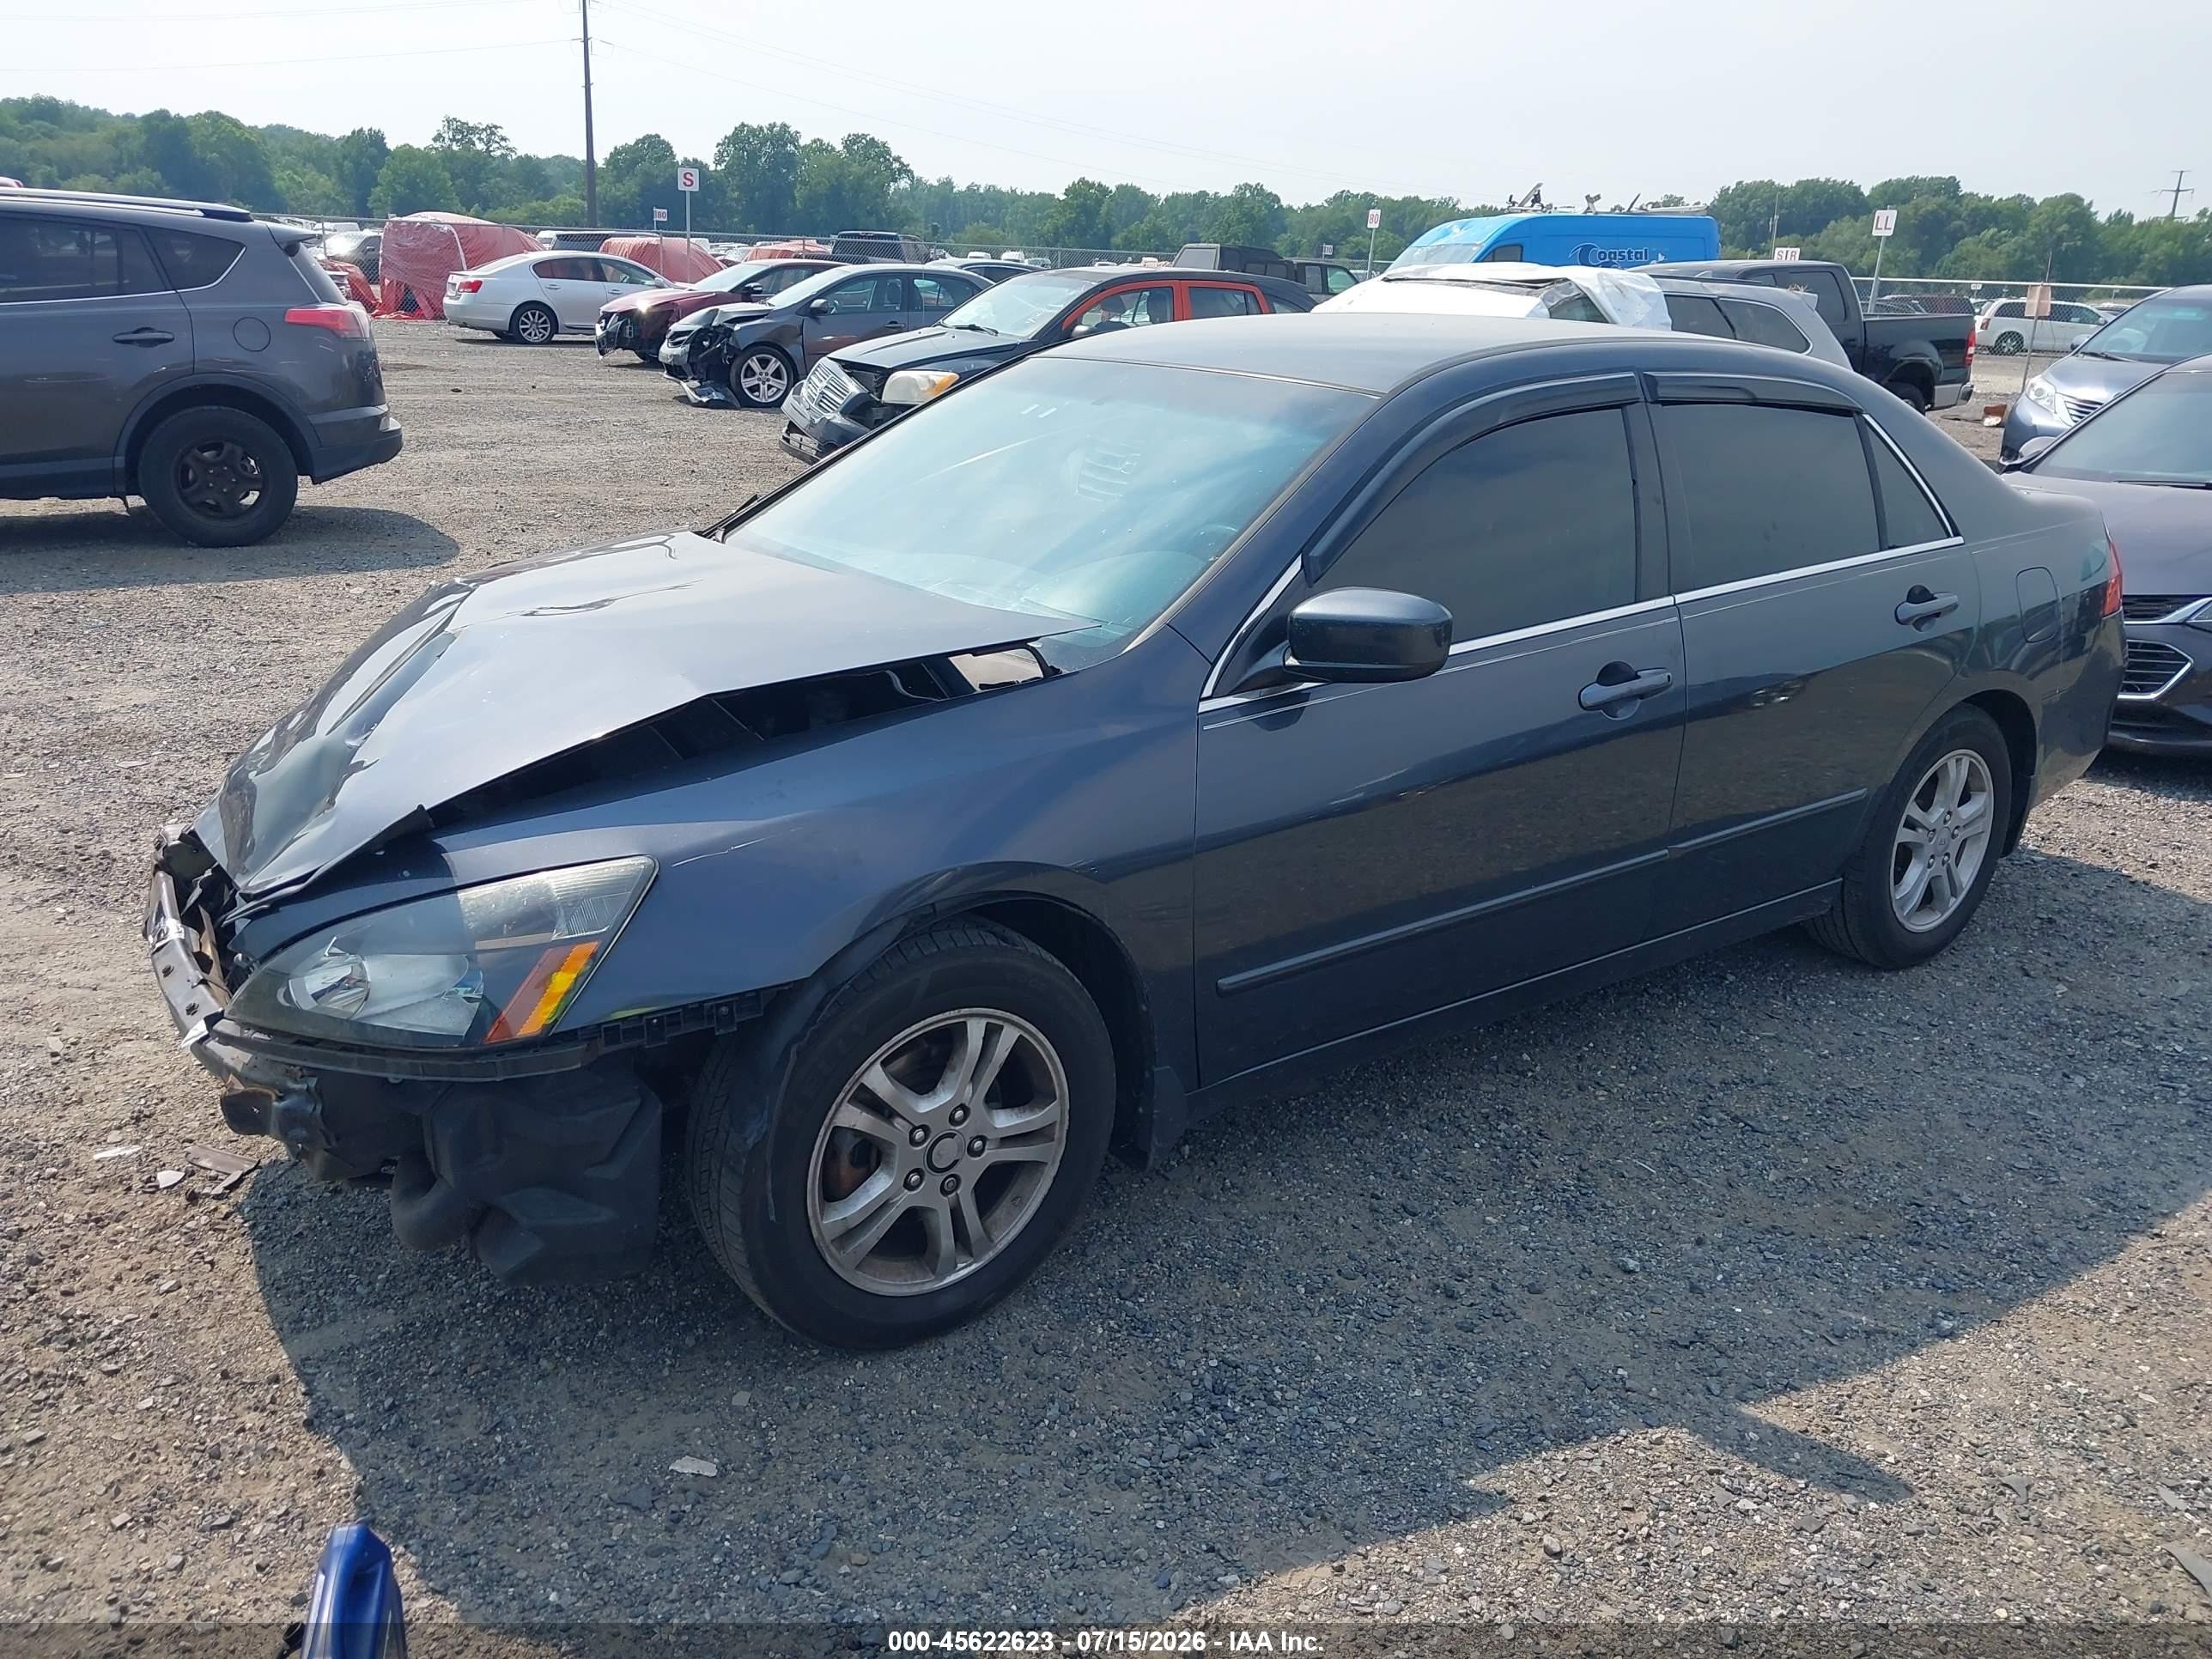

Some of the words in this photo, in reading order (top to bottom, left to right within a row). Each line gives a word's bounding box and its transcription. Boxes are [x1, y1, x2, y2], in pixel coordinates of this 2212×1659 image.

[683, 172, 694, 187] S
[1370, 213, 1379, 224] 80
[1875, 216, 1893, 231] LL
[1580, 244, 1649, 265] Coastal
